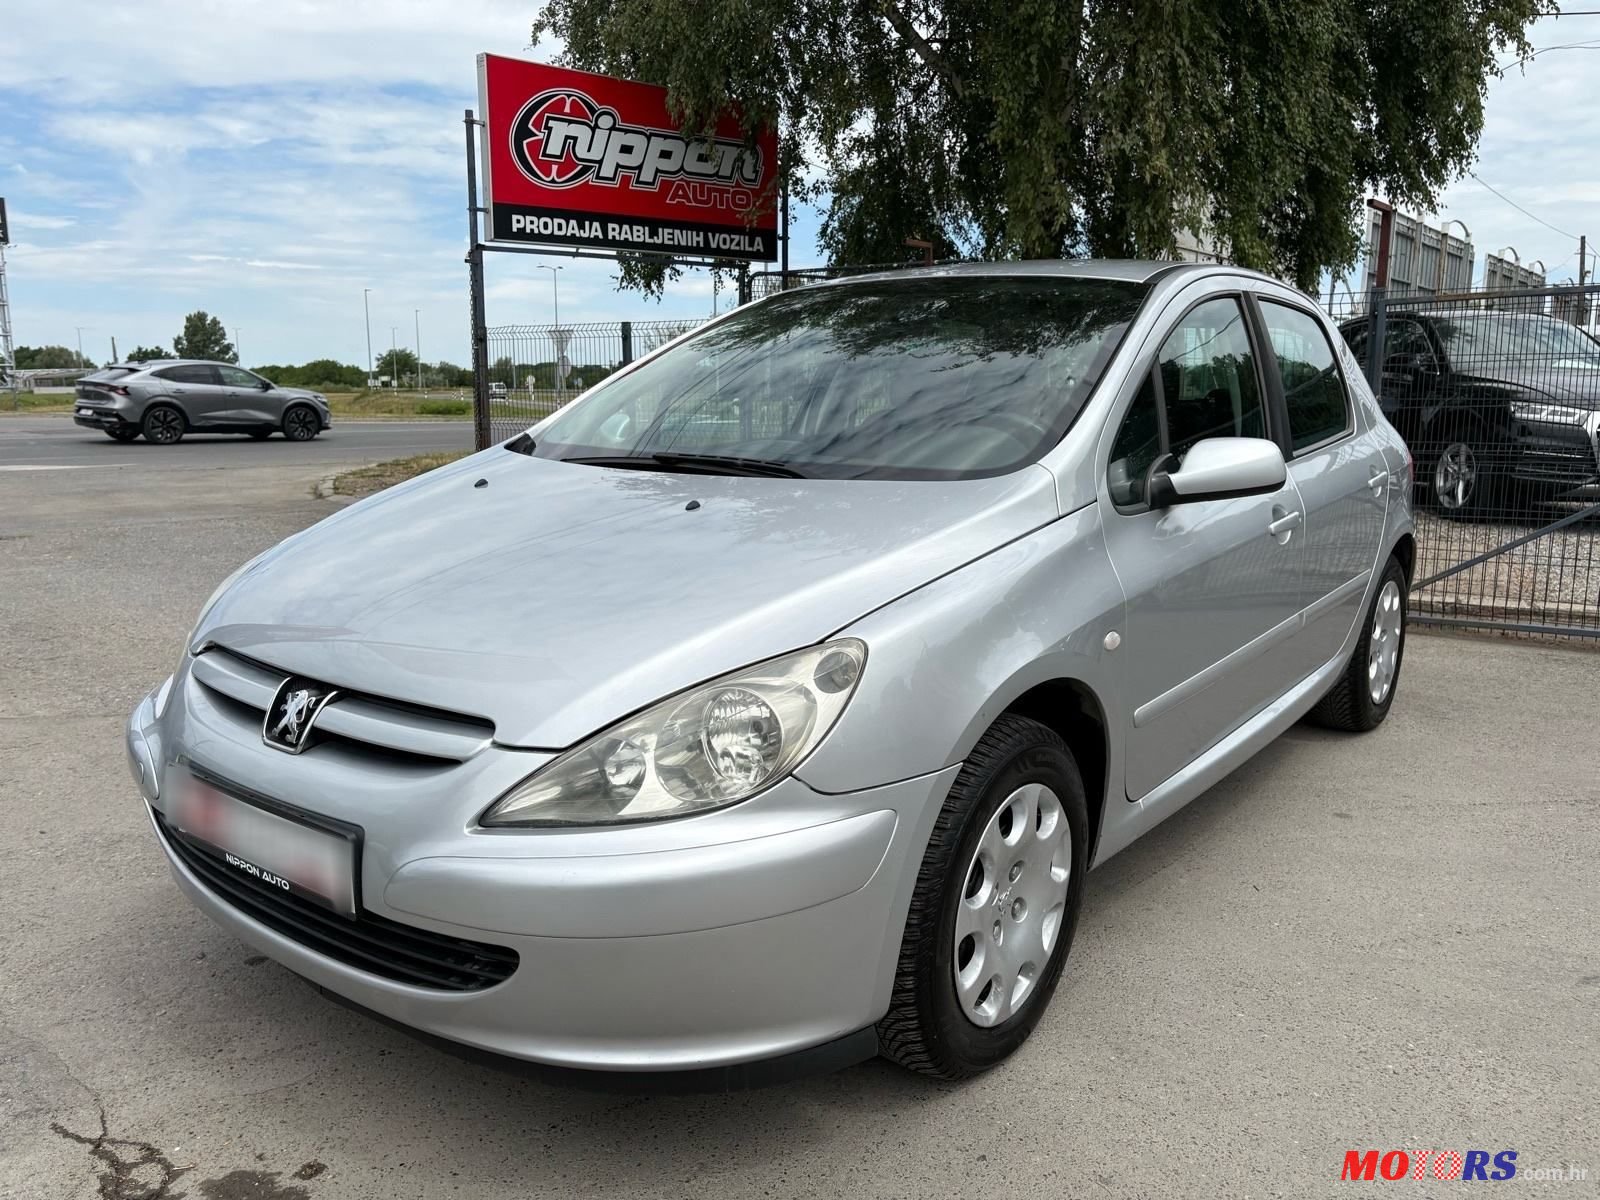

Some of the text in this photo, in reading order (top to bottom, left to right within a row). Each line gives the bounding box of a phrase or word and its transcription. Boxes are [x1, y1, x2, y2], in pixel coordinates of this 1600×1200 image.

[542, 108, 760, 187] nippon
[666, 181, 753, 211] AUTO
[511, 214, 764, 252] PRODAJA RABLJENIH VOZILA
[225, 852, 290, 891] NIPPON AUTO
